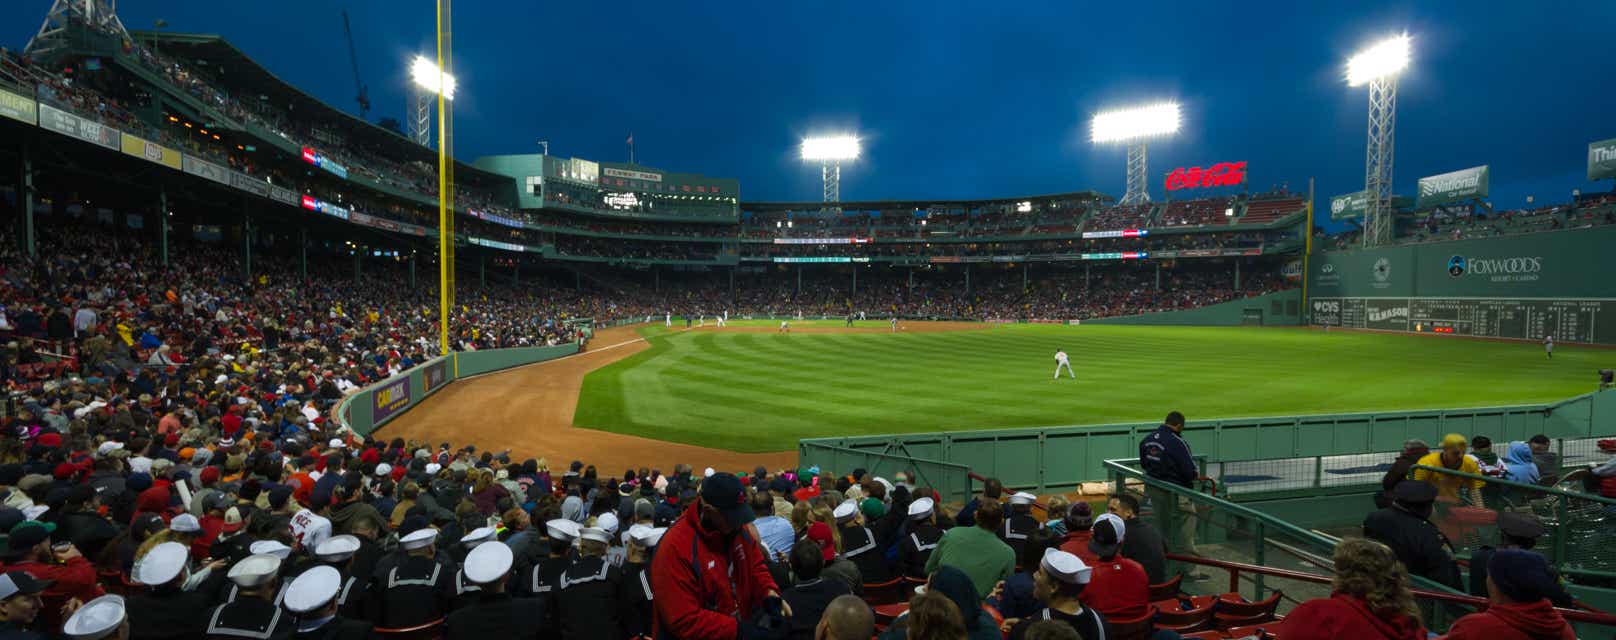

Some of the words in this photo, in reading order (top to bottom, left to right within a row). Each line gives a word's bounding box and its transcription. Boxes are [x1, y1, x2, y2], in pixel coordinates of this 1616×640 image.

[1592, 145, 1616, 163] Thi
[1434, 172, 1480, 193] National
[1467, 257, 1543, 274] FOXWOODS
[1321, 301, 1340, 313] CVS
